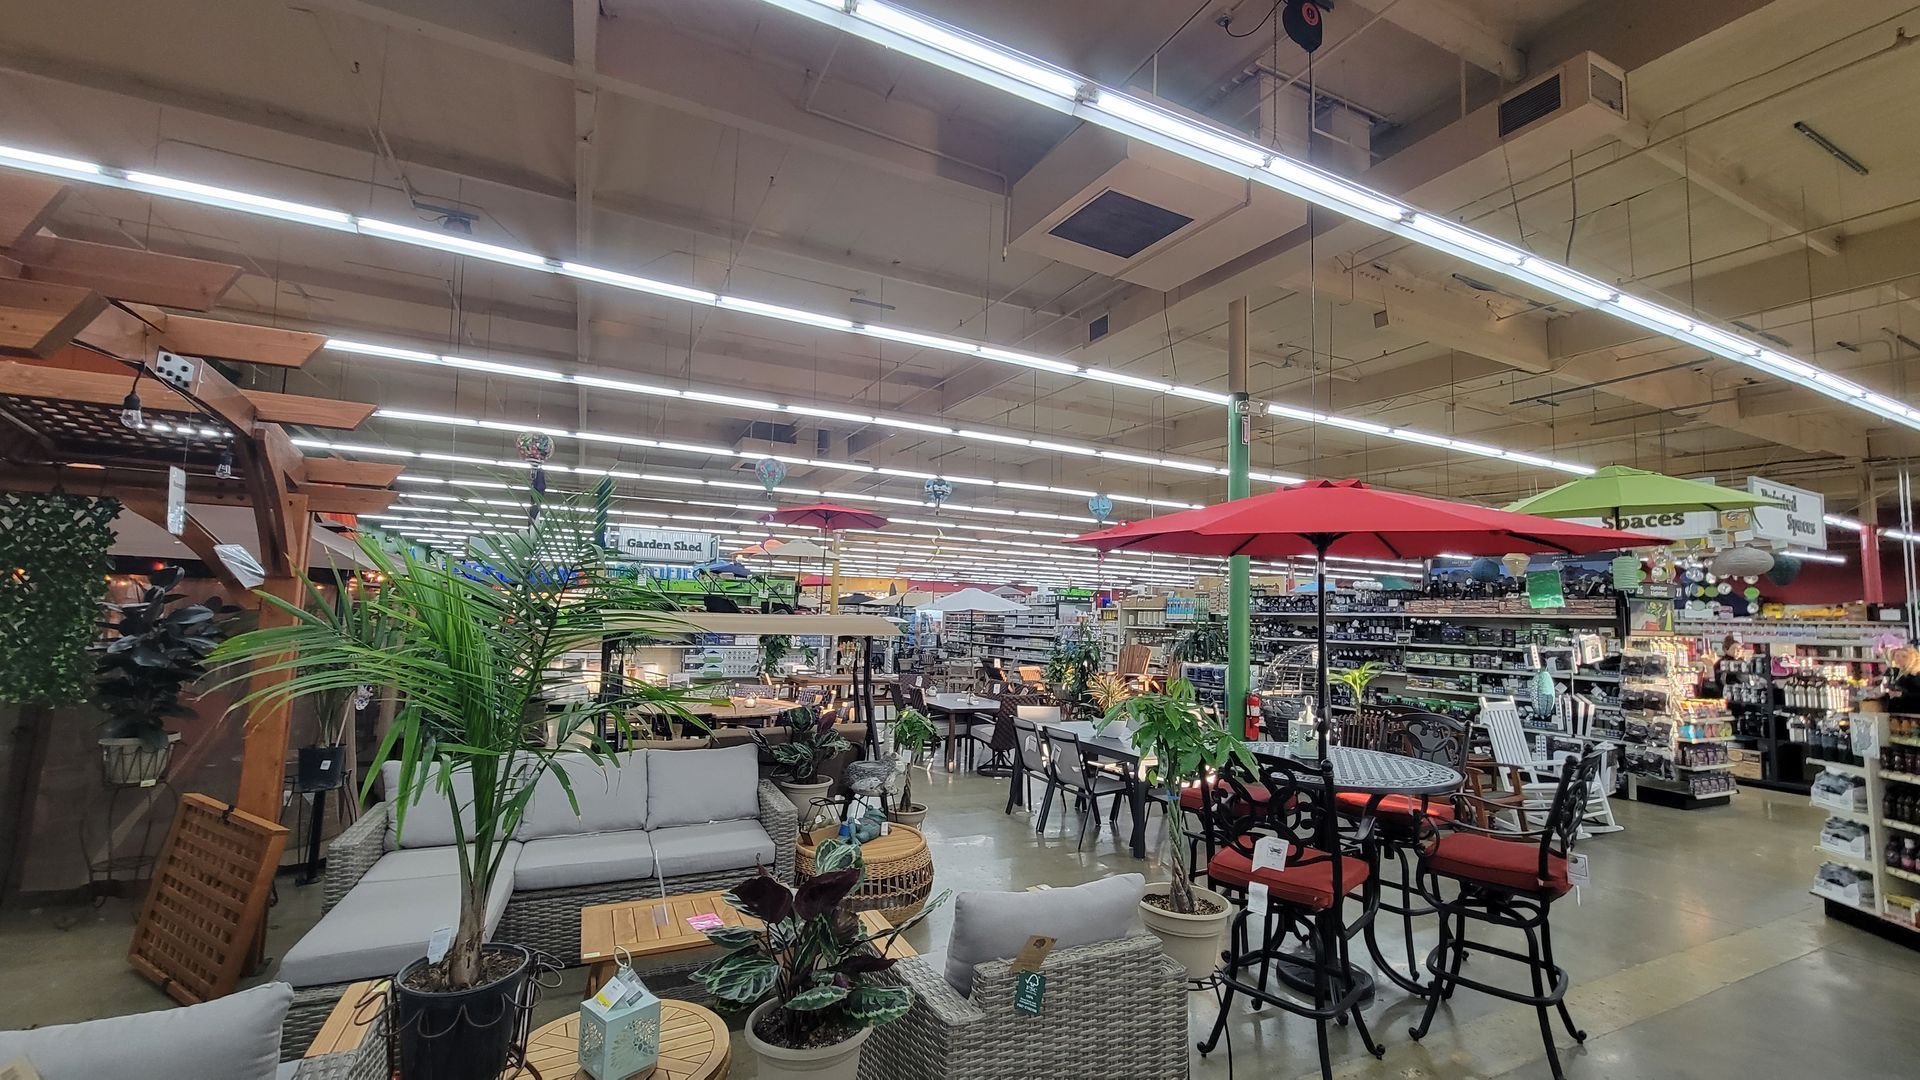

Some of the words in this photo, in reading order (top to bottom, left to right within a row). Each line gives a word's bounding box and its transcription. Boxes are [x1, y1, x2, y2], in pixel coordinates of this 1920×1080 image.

[1786, 513, 1816, 536] Spaces
[627, 538, 671, 551] Garden
[673, 541, 703, 552] Shed
